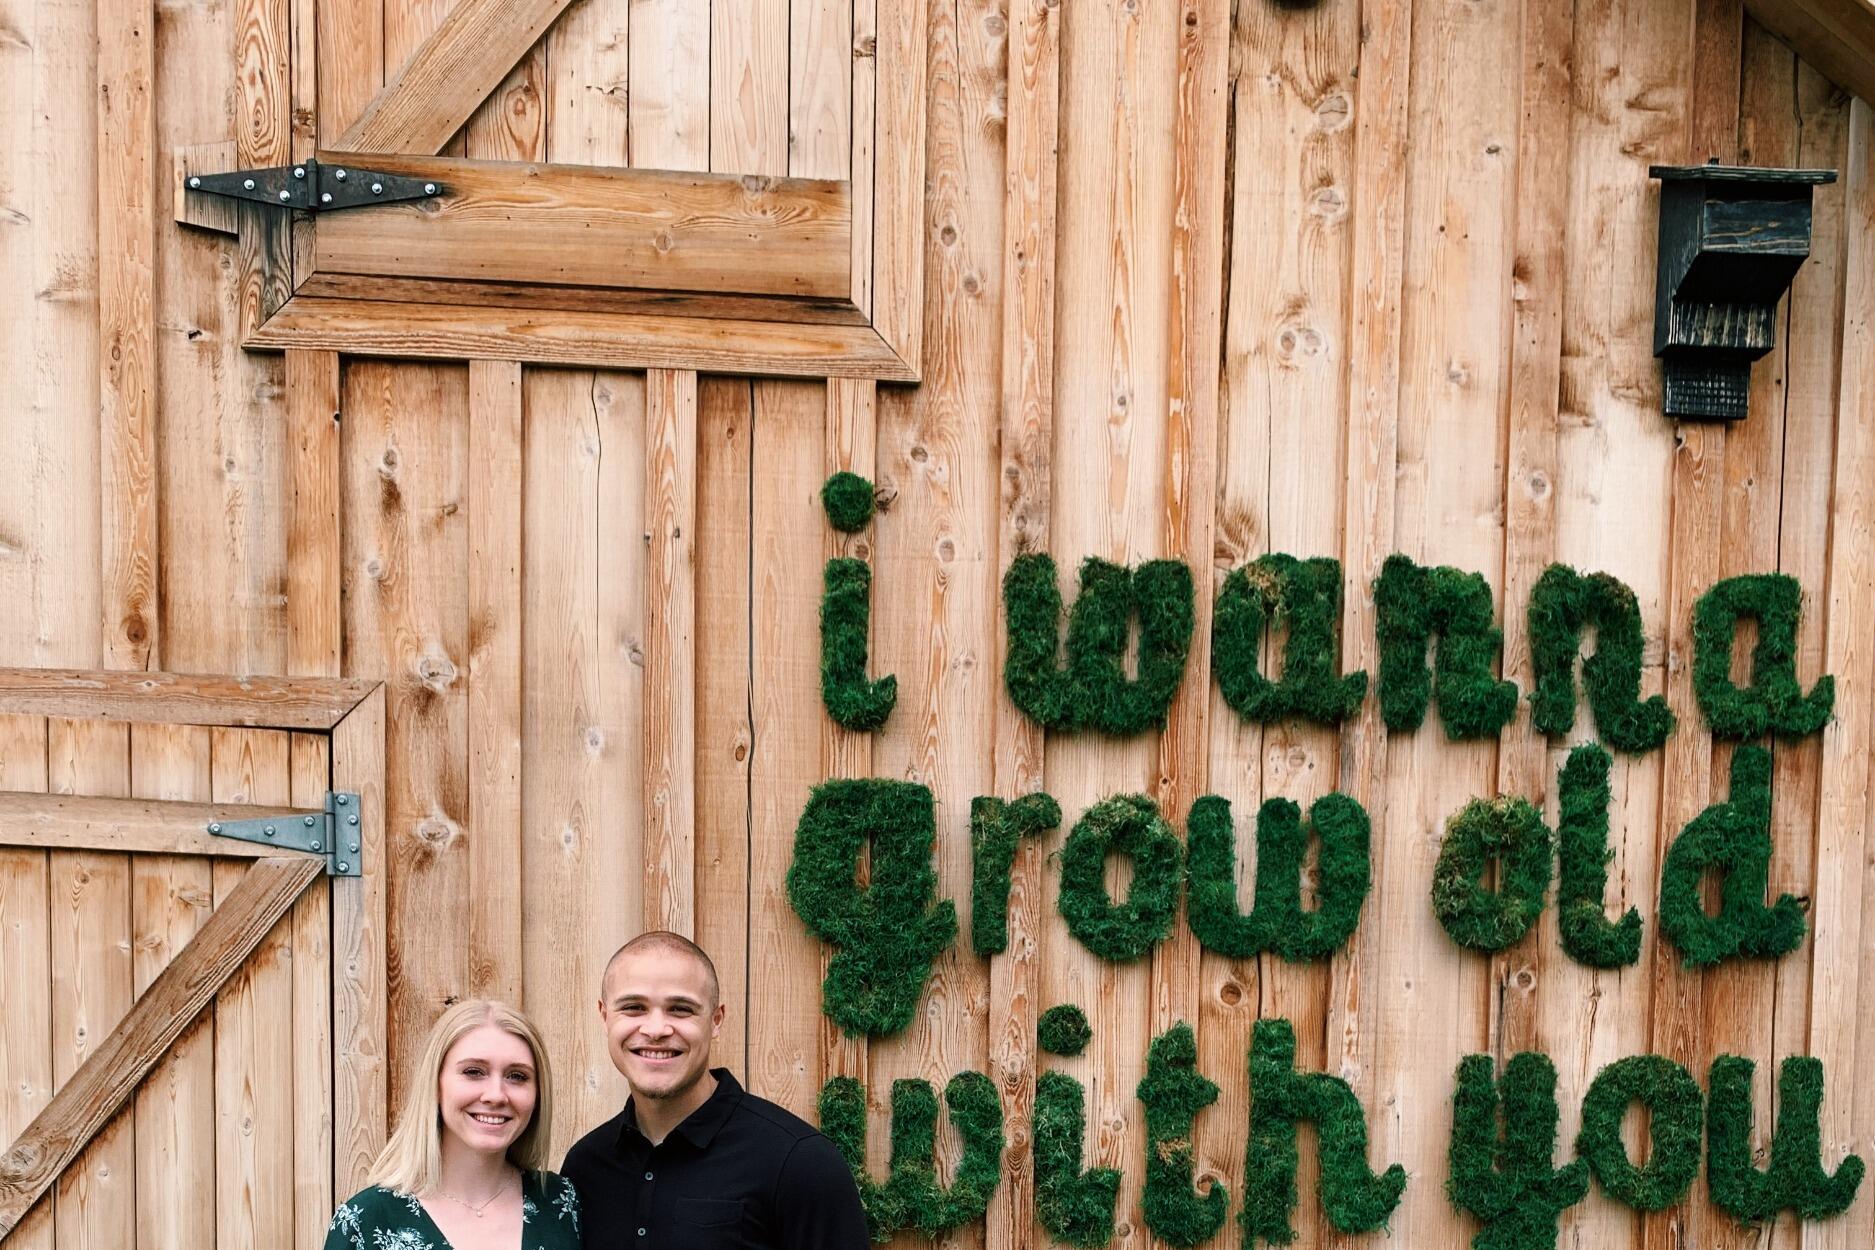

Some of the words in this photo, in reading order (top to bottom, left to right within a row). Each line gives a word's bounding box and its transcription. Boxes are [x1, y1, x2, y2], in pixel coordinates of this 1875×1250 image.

[820, 471, 897, 731] i
[1002, 552, 1836, 756] wanna
[786, 777, 1371, 1038] grow
[1433, 743, 1810, 969] old
